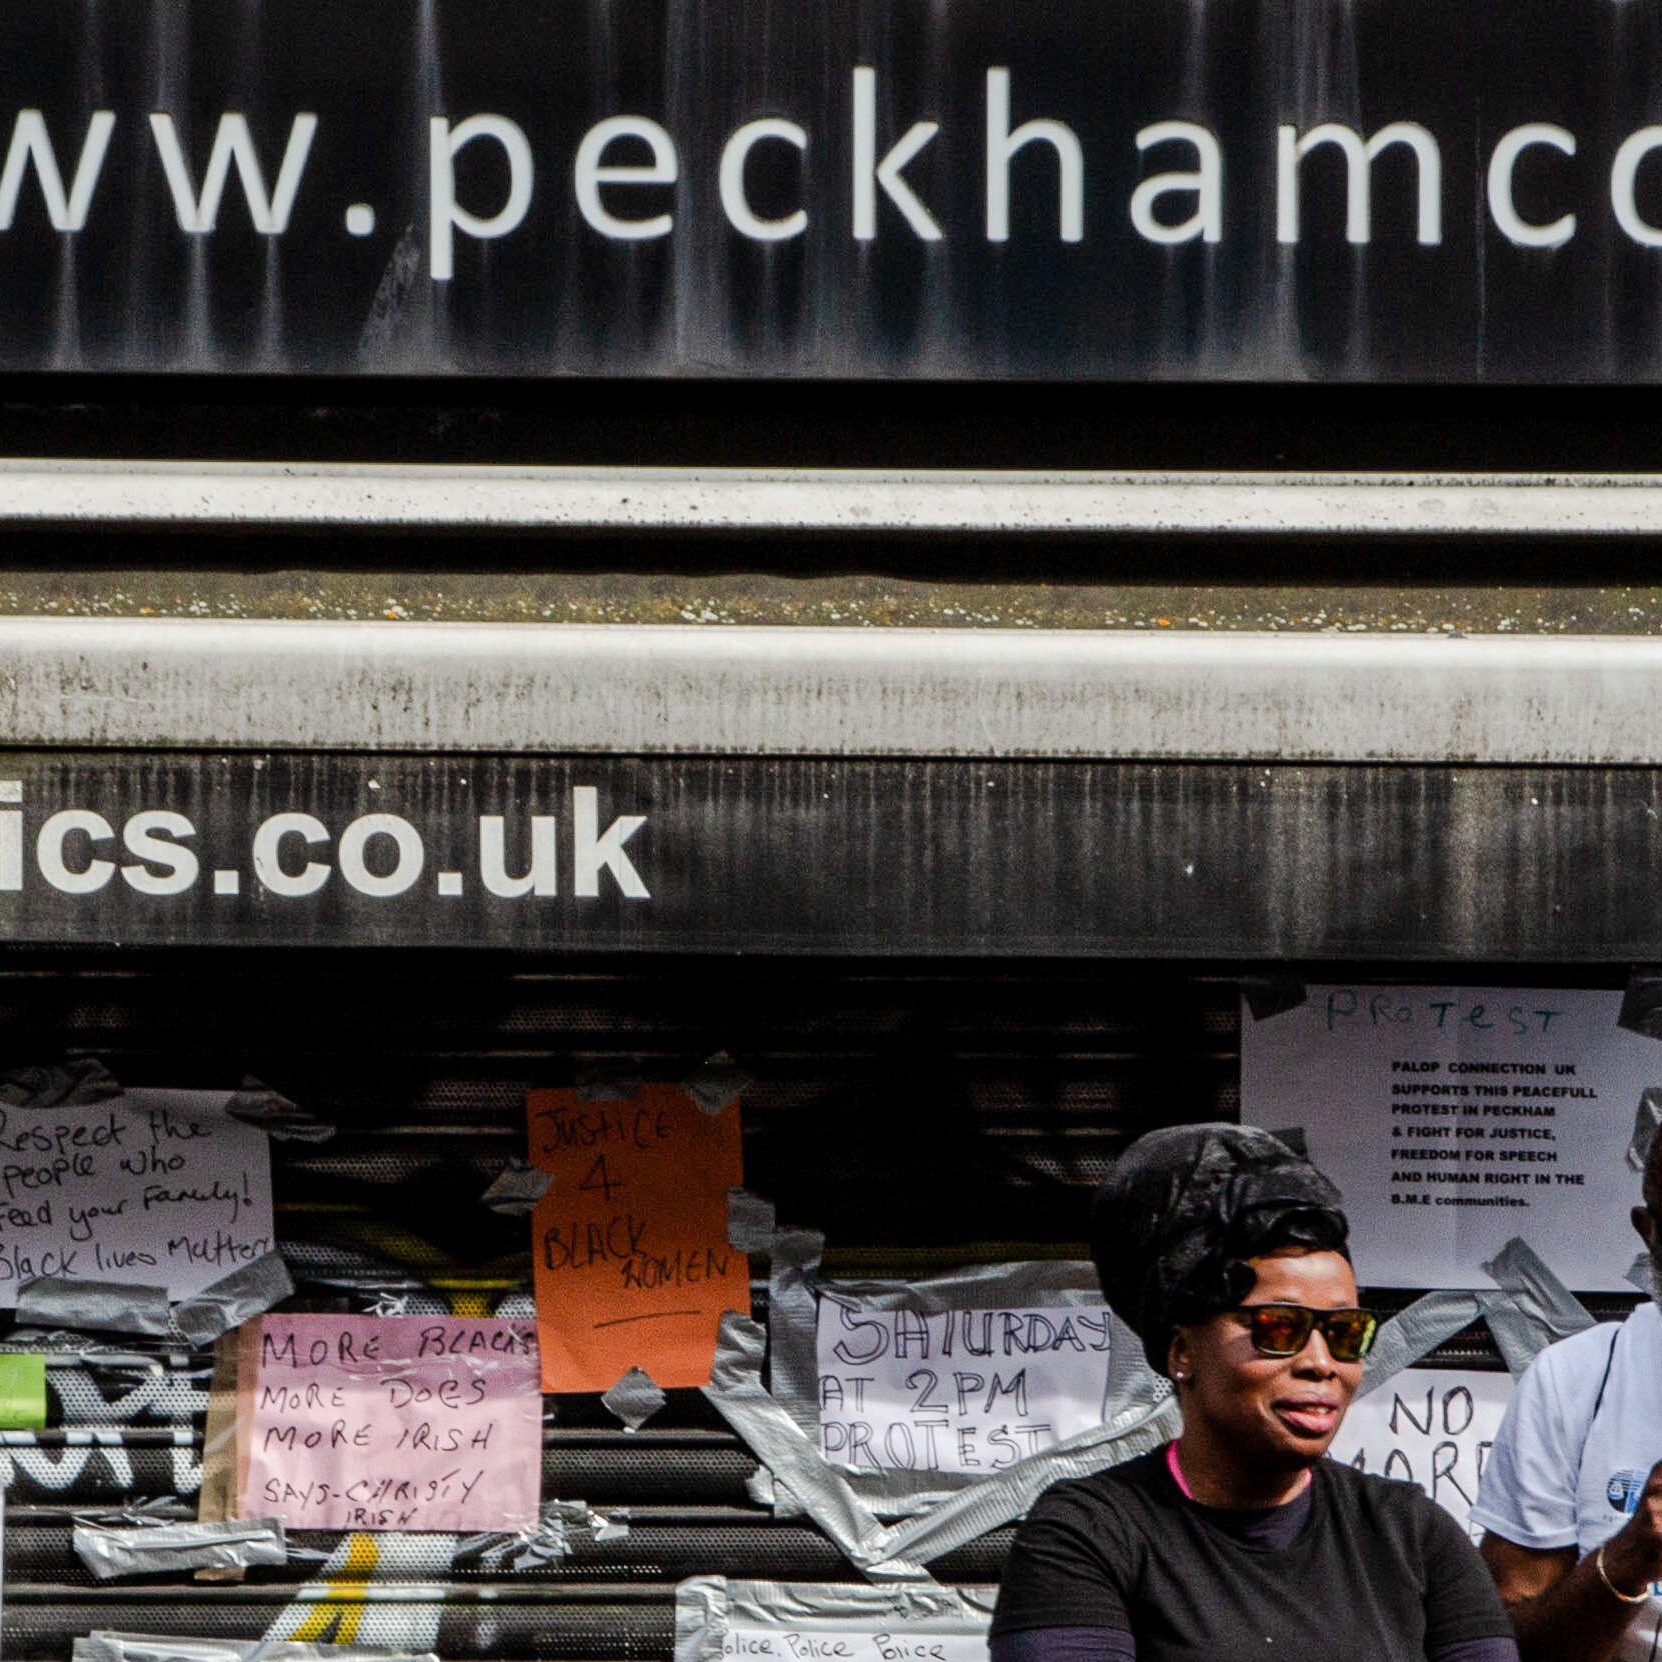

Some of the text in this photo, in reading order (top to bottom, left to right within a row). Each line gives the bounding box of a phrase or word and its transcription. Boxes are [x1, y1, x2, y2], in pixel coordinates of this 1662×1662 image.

[1449, 1062, 1545, 1074] CONNECTION
[1555, 1064, 1575, 1075] UK
[1392, 1084, 1597, 1098] SUPPORTS THIS PEACEFULL
[150, 1109, 212, 1145] the
[1392, 1104, 1555, 1117] PROTEST IN PECKHAM
[1392, 1127, 1556, 1141] & FIGHT FOR JUSTICE,
[1391, 1150, 1557, 1162] FREEDOM FOR SPEECH
[3, 1154, 94, 1198] people
[580, 1154, 625, 1202] 4
[1391, 1172, 1585, 1185] AND HUMAN RIGHT IN THE
[1436, 1195, 1529, 1207] communities.
[69, 1199, 125, 1242] your
[544, 1215, 646, 1271] BLACK
[622, 1248, 728, 1289] WOMEN
[262, 1331, 383, 1368] MORE
[833, 1308, 1113, 1365] SATURDAY
[259, 1381, 347, 1411] MORE
[819, 1368, 1029, 1418] AT 2PM
[1389, 1385, 1474, 1436] NO
[263, 1422, 495, 1454] MORE IRISH
[821, 1418, 1053, 1471] PROTEST
[345, 1507, 420, 1528] IRISH
[784, 1633, 947, 1661] Police Police
